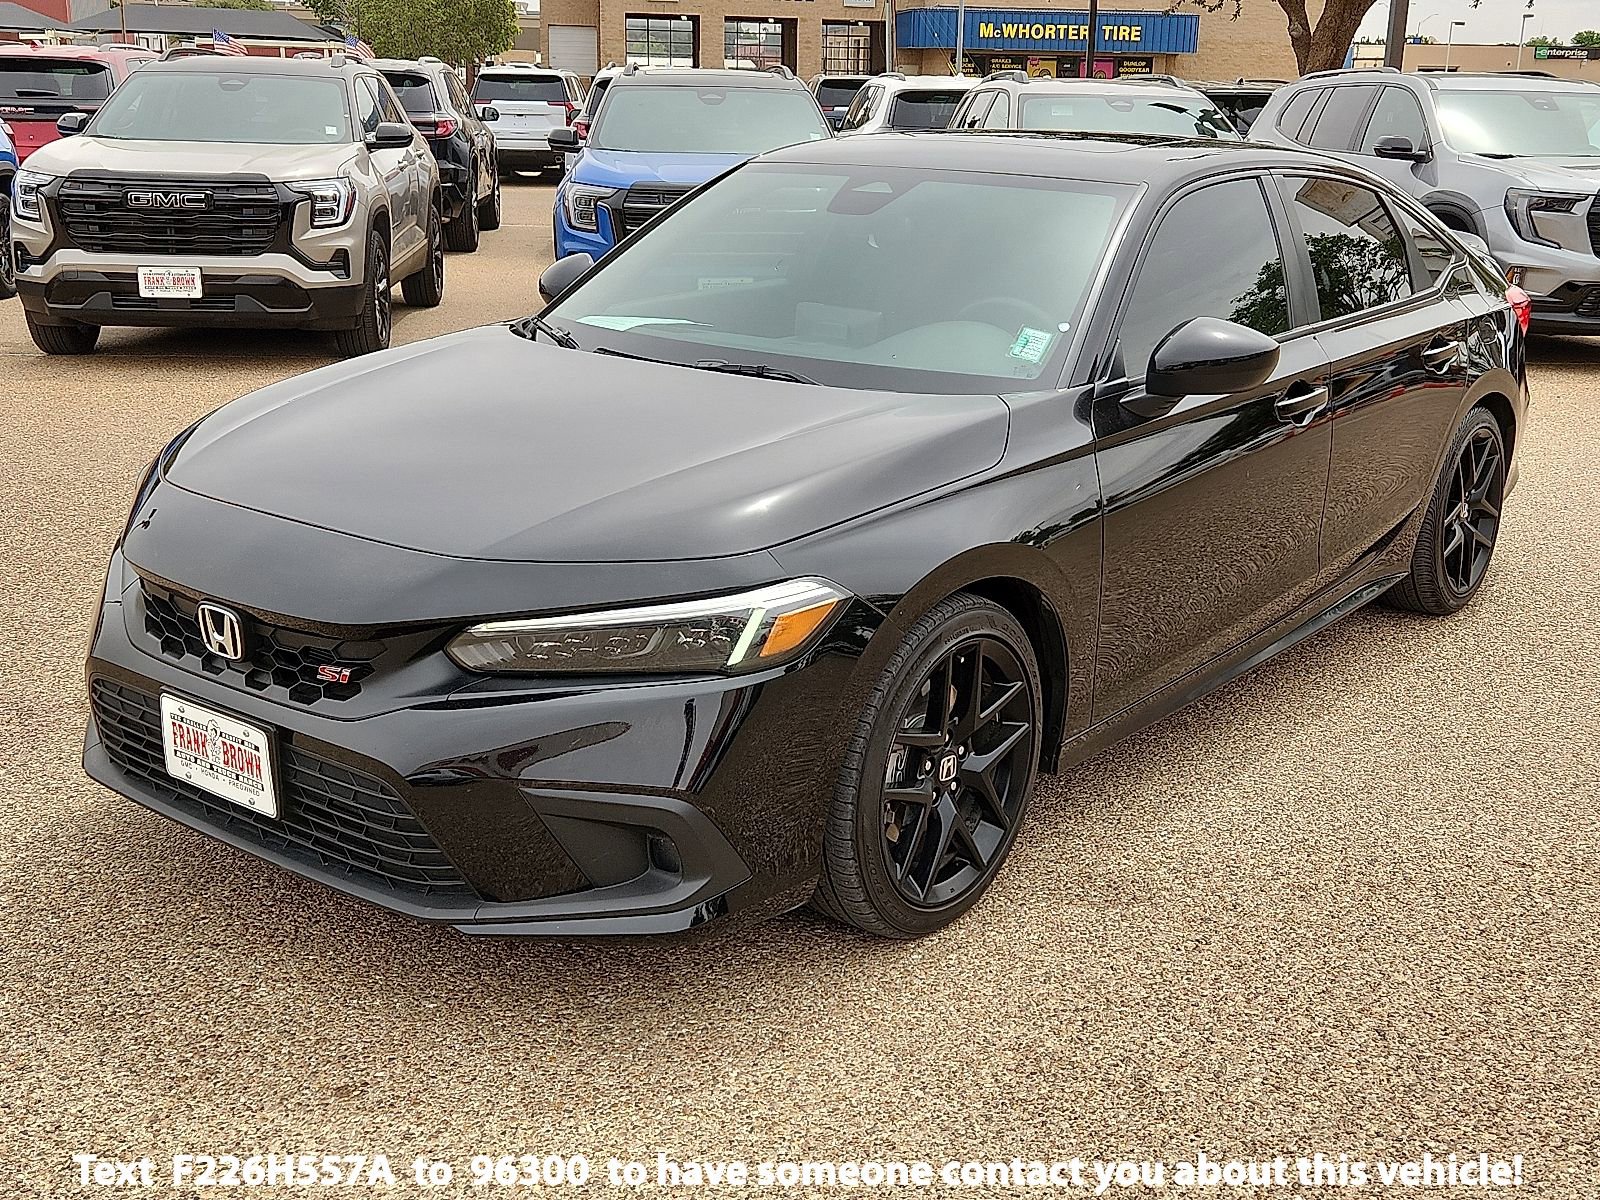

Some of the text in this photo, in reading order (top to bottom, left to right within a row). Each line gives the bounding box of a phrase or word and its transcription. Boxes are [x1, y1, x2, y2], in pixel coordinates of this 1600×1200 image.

[1101, 25, 1142, 41] TIRE
[1540, 49, 1588, 57] enterprise
[127, 192, 206, 208] GMC
[144, 276, 196, 287] FRANK BROWN
[316, 665, 351, 683] Si
[172, 721, 262, 780] FRANK BROWN
